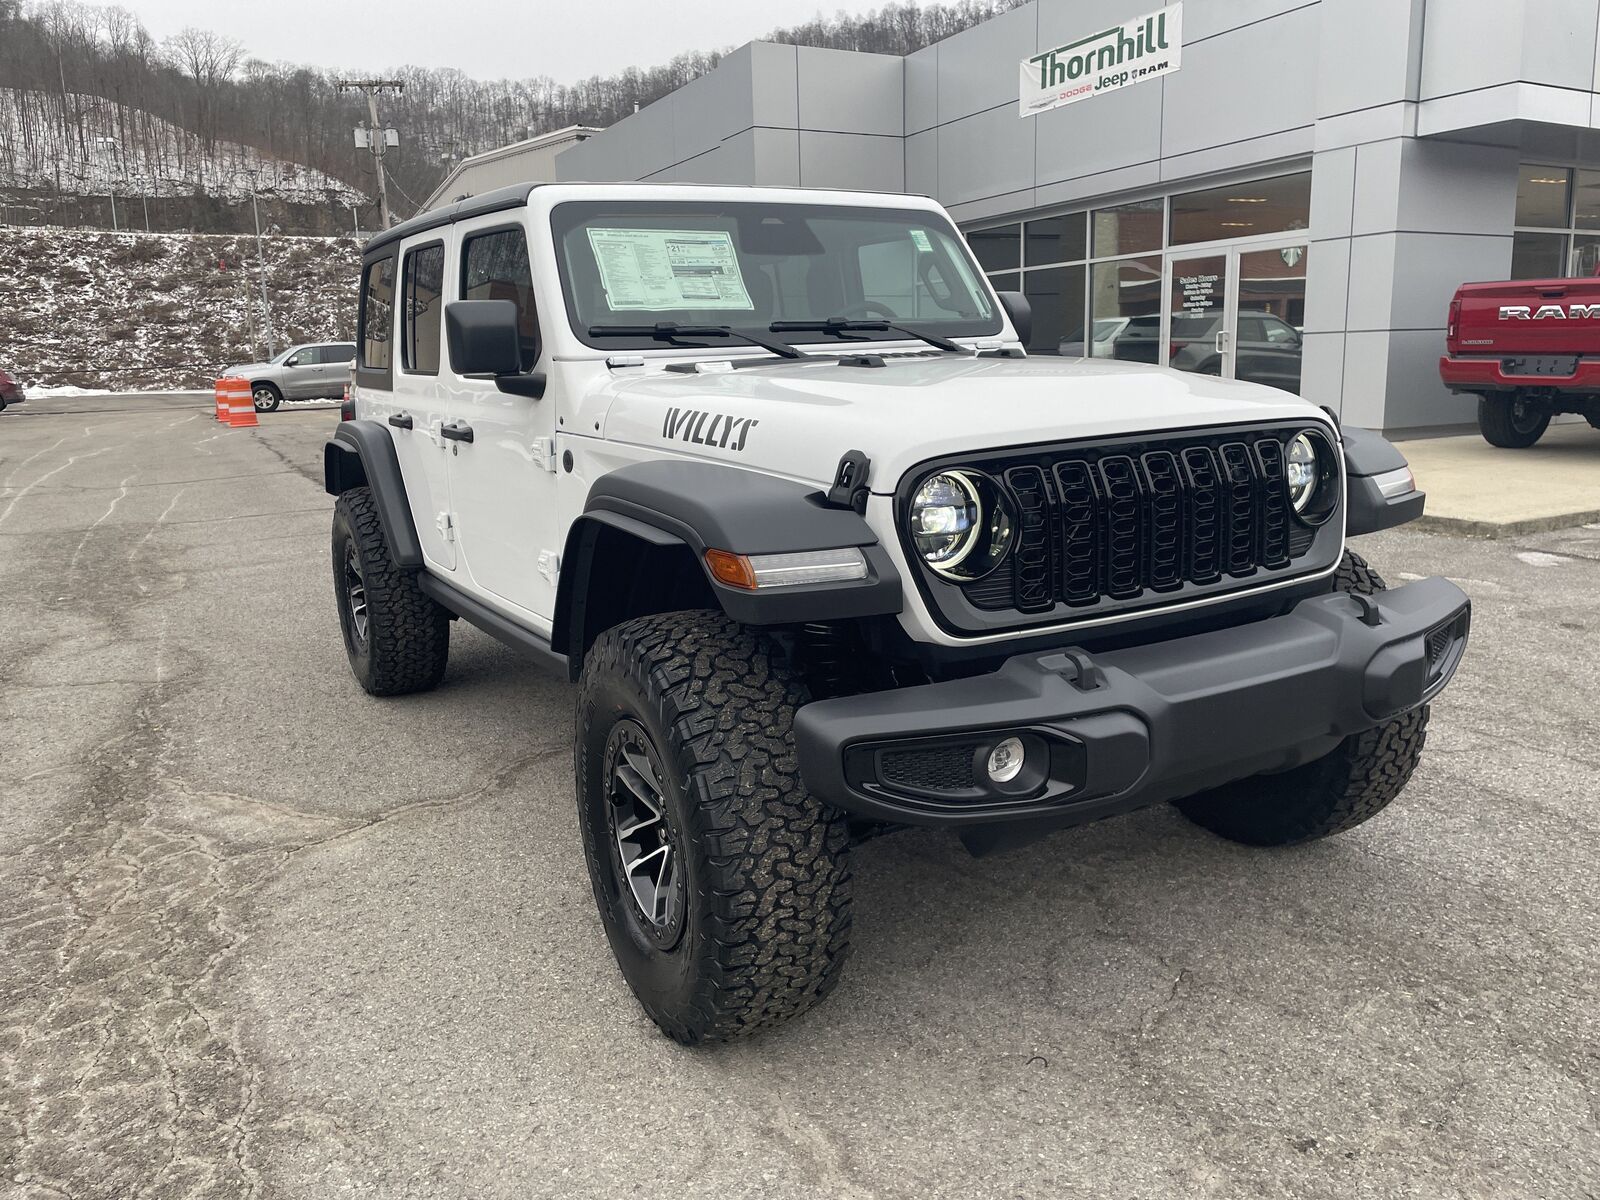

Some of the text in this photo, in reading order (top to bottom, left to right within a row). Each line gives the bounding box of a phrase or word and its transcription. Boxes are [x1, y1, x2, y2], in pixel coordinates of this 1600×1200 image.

[1029, 12, 1169, 90] Thornhill
[1059, 61, 1169, 100] DODGE Jeep RAM
[1498, 304, 1600, 320] RAM
[662, 407, 759, 451] WILLYS
